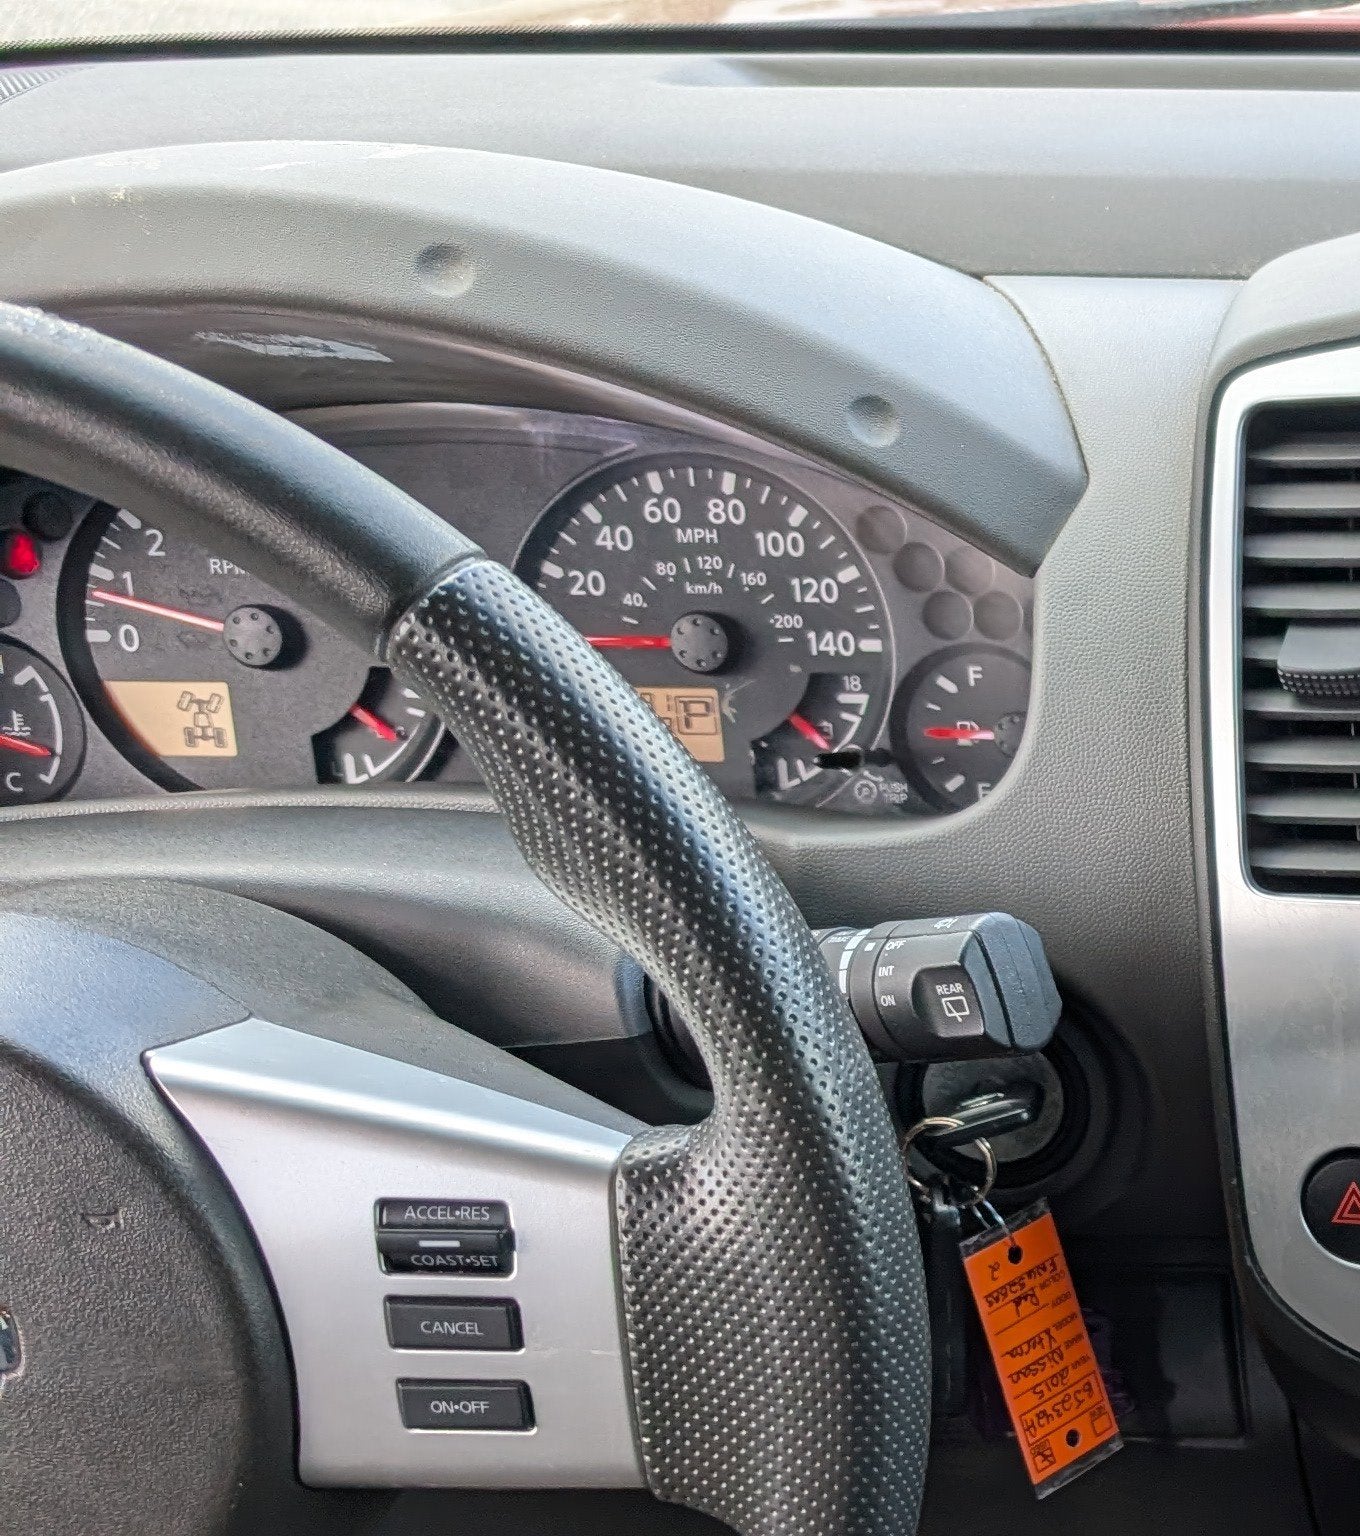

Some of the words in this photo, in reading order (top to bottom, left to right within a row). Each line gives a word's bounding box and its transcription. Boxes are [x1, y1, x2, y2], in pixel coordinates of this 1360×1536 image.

[644, 499, 681, 524] 60
[708, 499, 745, 525] 80
[145, 528, 166, 557] 2
[595, 526, 633, 551] 40
[676, 529, 718, 545] MPH
[755, 531, 804, 558] 100
[656, 560, 677, 578] 80
[696, 555, 723, 572] 120
[122, 571, 135, 596] 1
[568, 571, 606, 597] 20
[685, 581, 723, 595] km/h
[740, 570, 766, 587] 160
[623, 592, 644, 608] 40
[791, 577, 838, 605] 120
[774, 613, 804, 630] 200
[118, 623, 140, 653] 0
[806, 630, 856, 657] 140
[843, 675, 862, 692] 18
[967, 666, 983, 686] F
[678, 699, 716, 729] P
[6, 771, 23, 792] C
[977, 782, 992, 802] E
[878, 966, 895, 977] INT
[935, 983, 965, 996] REAR
[880, 995, 896, 1007] ON
[420, 1321, 485, 1336] CANCEL
[1031, 1366, 1070, 1400] 2015
